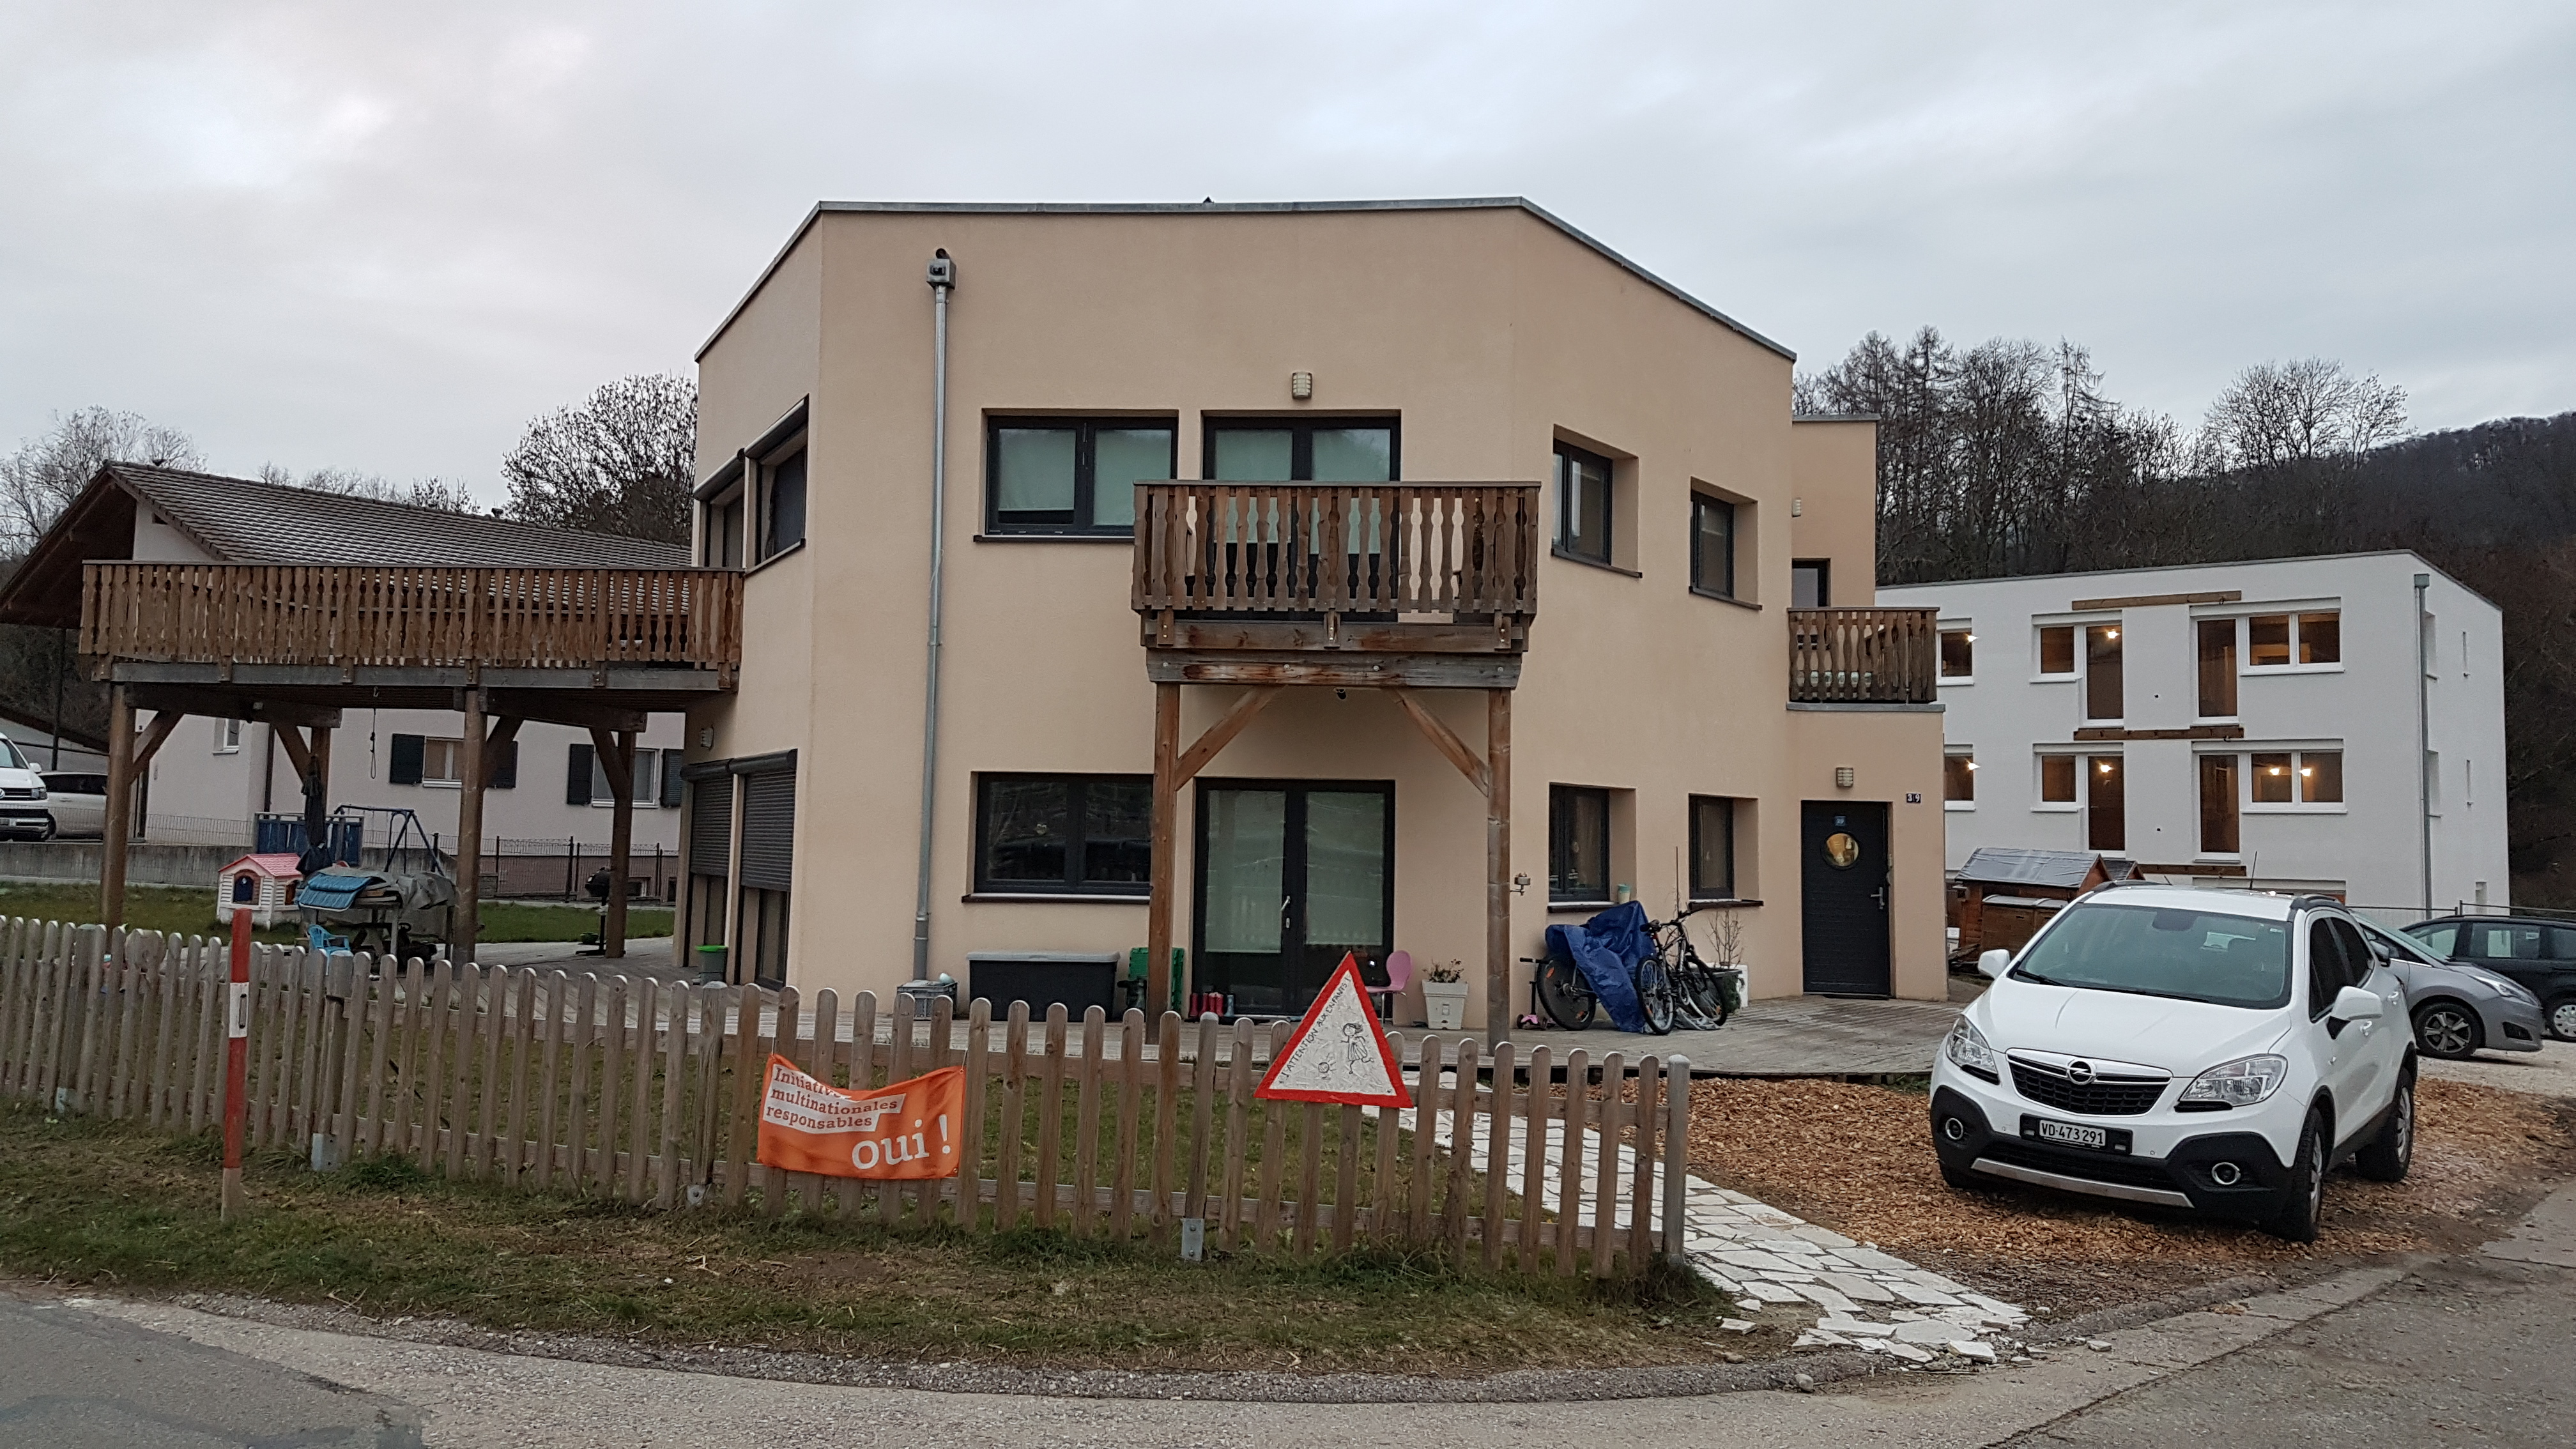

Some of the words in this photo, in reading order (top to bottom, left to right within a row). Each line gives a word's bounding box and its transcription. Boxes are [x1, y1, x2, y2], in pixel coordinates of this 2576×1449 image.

[1908, 793, 1920, 802] 39
[1287, 1028, 1319, 1072] ATTENTION
[1317, 1013, 1328, 1027] AUX
[1326, 982, 1347, 1014] ENFANTS
[770, 1088, 898, 1115] multinationales
[766, 1105, 873, 1130] responsables
